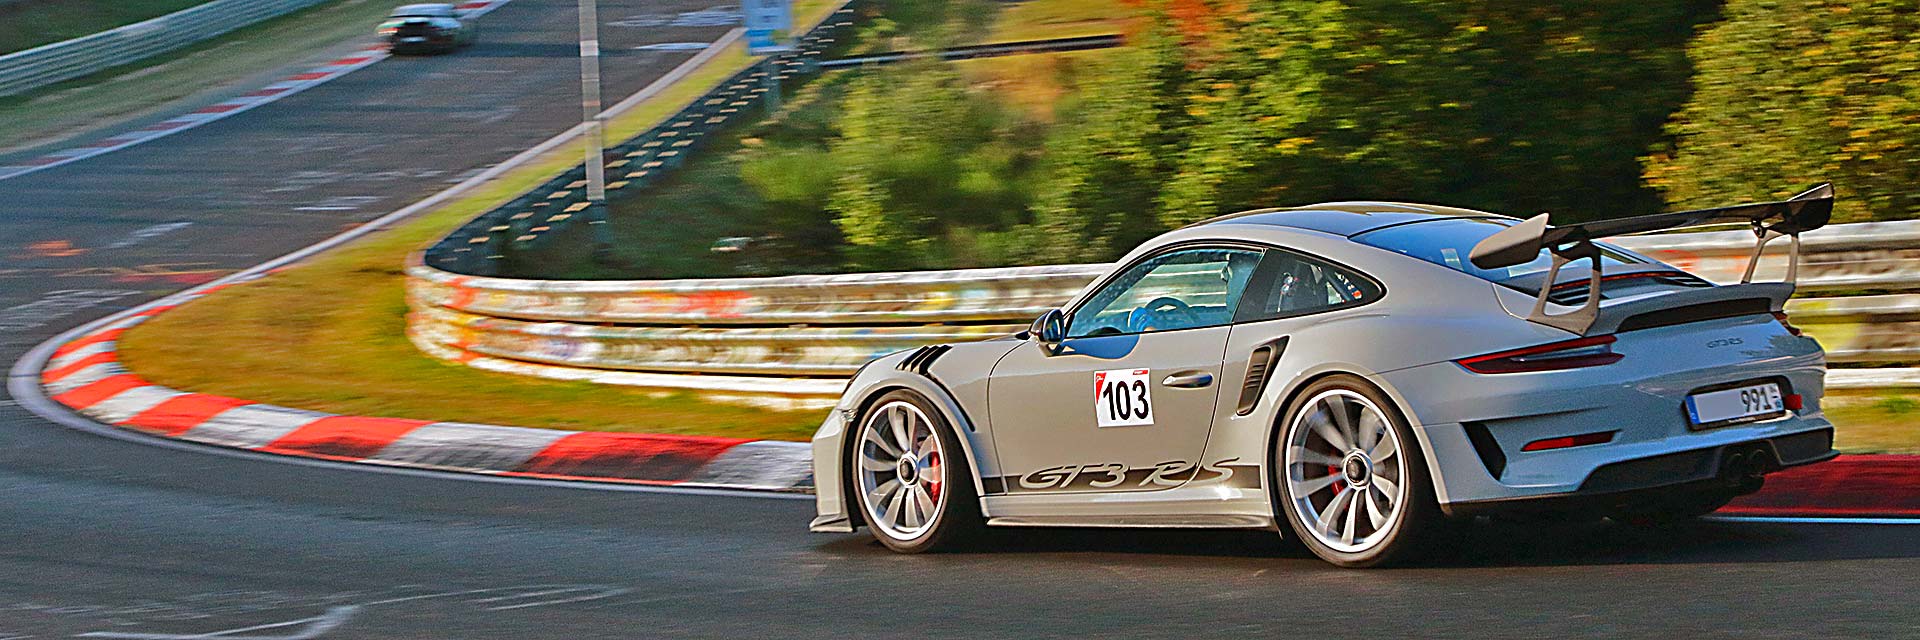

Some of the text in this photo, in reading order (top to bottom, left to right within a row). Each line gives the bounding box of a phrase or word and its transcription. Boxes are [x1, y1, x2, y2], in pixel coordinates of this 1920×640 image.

[1103, 380, 1149, 420] 103
[1741, 388, 1771, 412] 991
[1019, 463, 1128, 489] GT3
